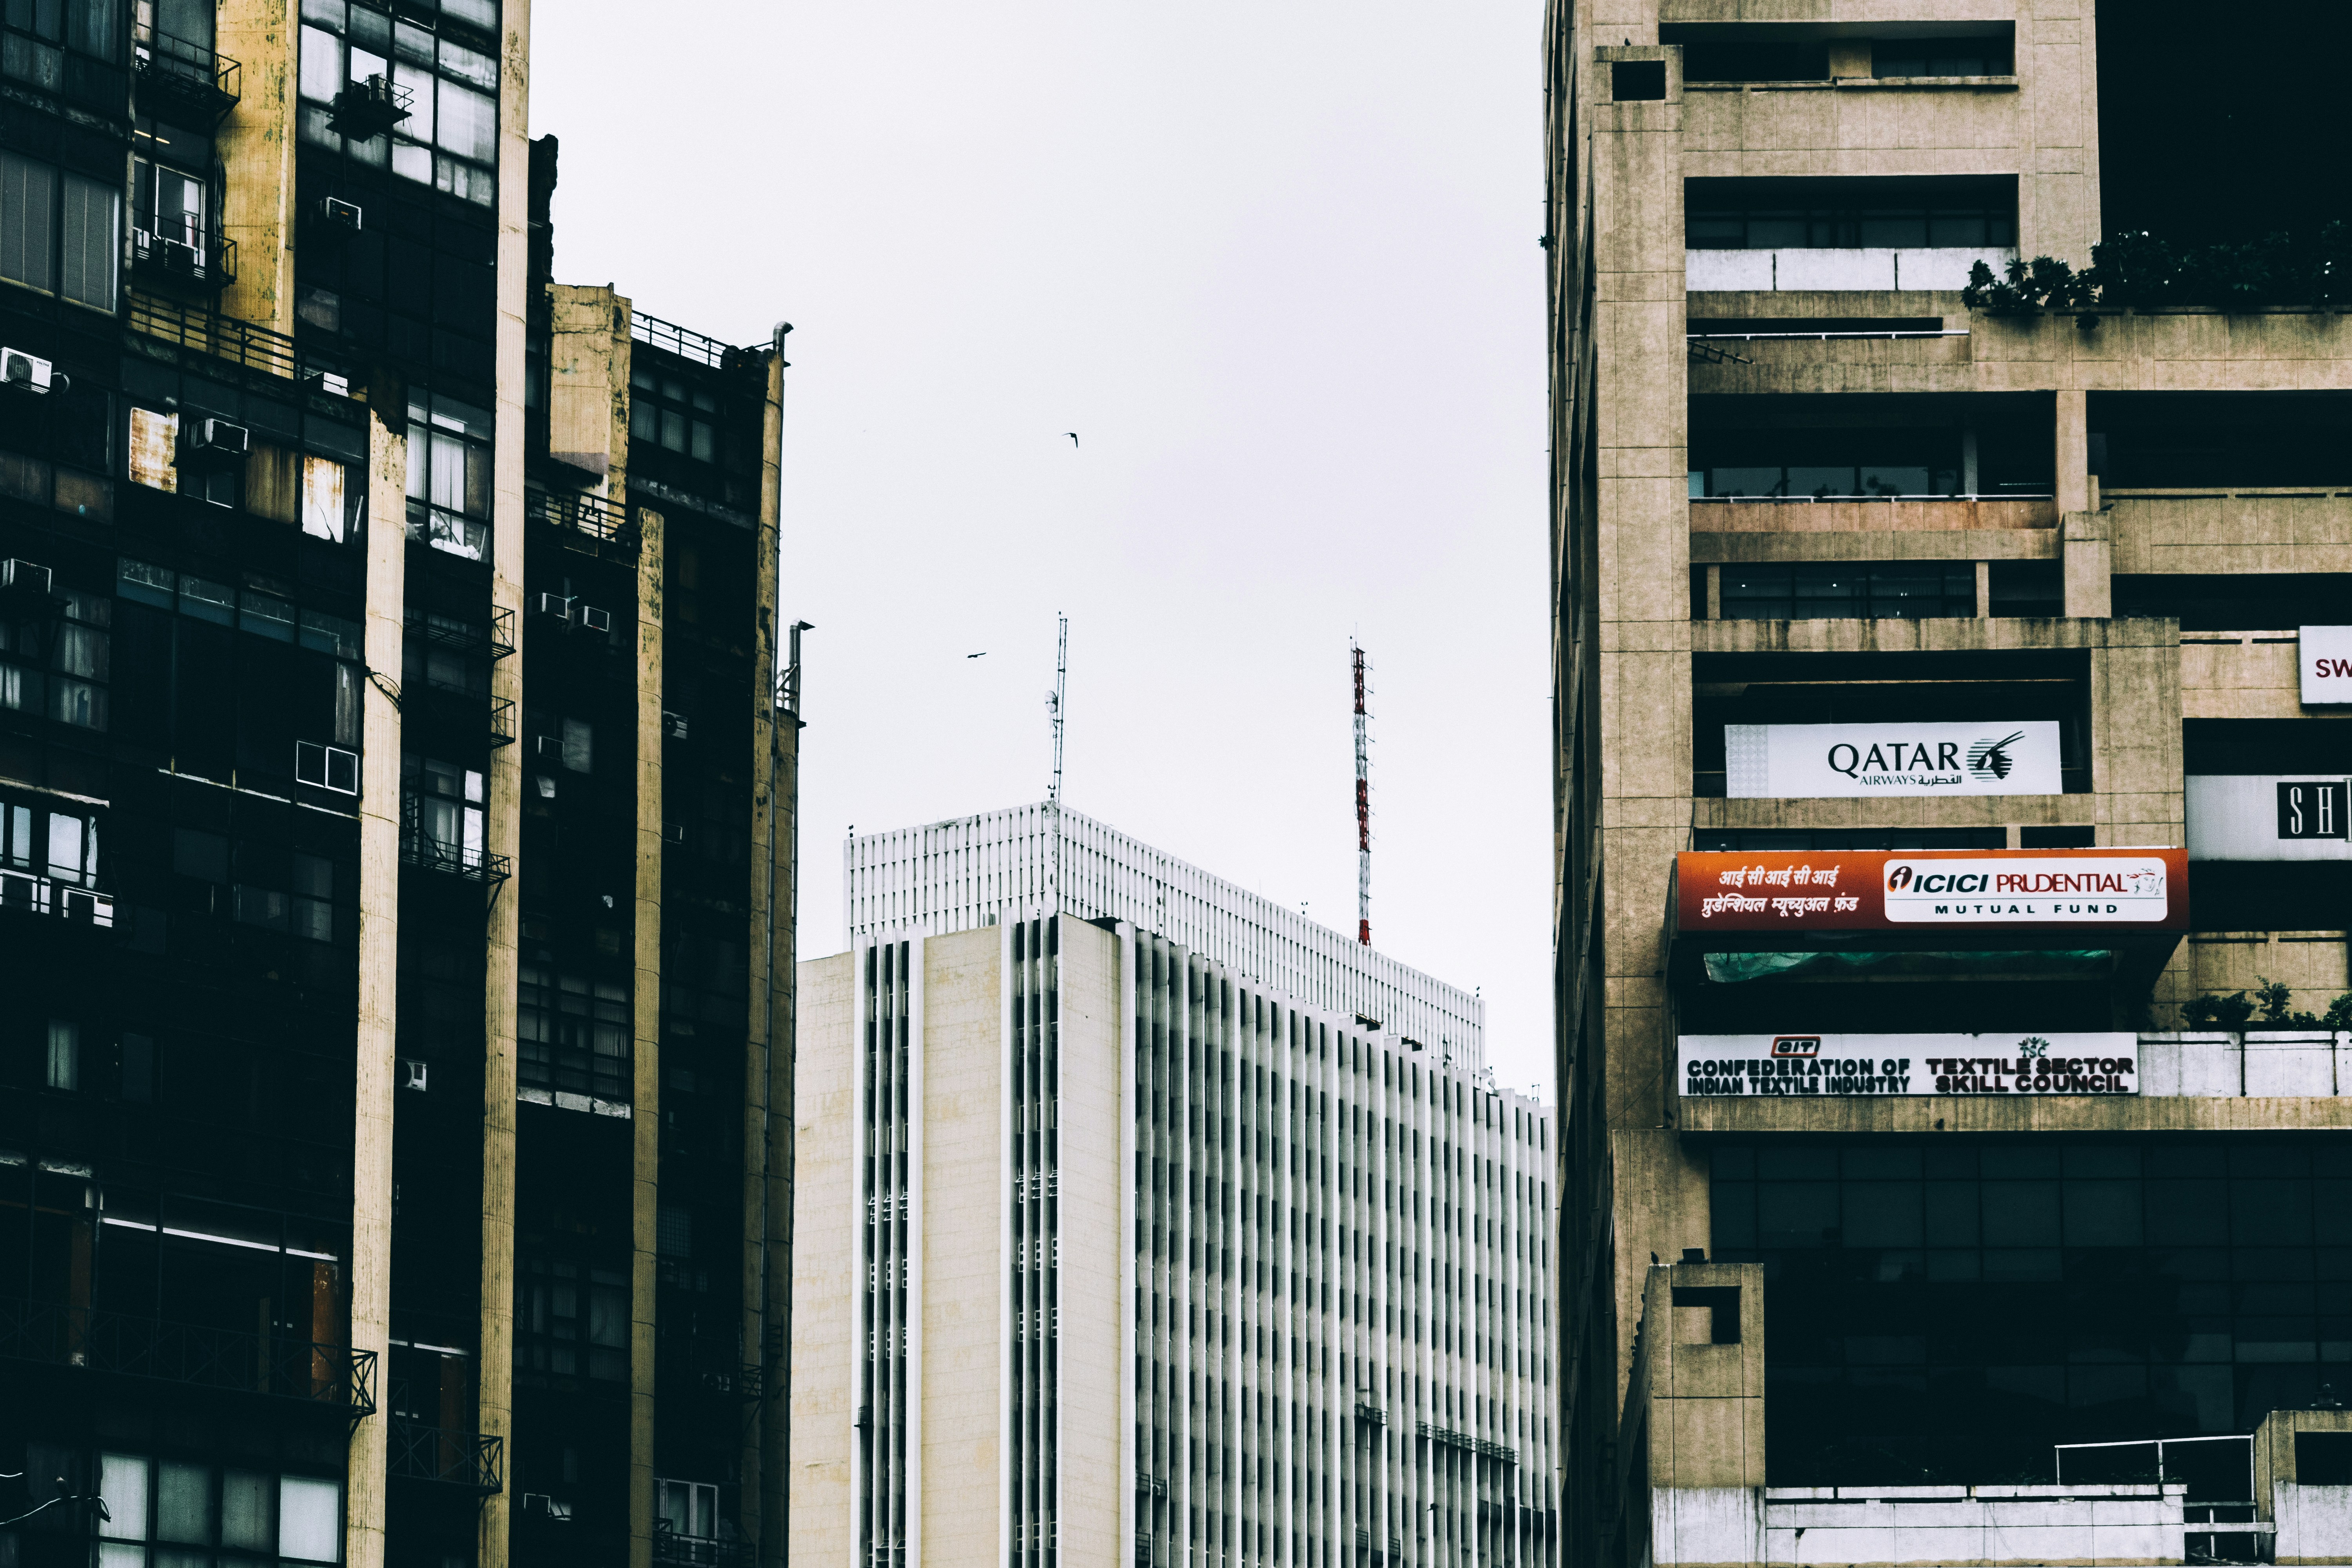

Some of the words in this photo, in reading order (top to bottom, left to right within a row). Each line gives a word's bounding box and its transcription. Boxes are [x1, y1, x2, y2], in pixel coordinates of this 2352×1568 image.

[2316, 659, 2352, 678] SW
[1828, 742, 1960, 779] QATAR
[1859, 774, 1916, 786] AIRWAYS
[1918, 774, 1962, 787] القطرية
[1719, 866, 1747, 888] आई
[1747, 865, 1765, 885] सी
[1764, 865, 1793, 888] आई
[1793, 864, 1812, 885] सी
[1811, 864, 1840, 888] आई
[1913, 873, 1989, 893] ICICI
[1996, 873, 2129, 893] PRUDENTIAL
[1935, 905, 2035, 914] MUTUAL
[2054, 904, 2118, 913] FUND
[2019, 1044, 2046, 1058] TSC
[1687, 1058, 1873, 1076] CONFEDERATION
[1881, 1058, 1910, 1075] OF
[1925, 1058, 2031, 1075] TEXTILE
[2036, 1058, 2134, 1074] SECTOR
[1687, 1076, 1743, 1094] INDIAN
[1749, 1076, 1819, 1094] TEXTILE
[1825, 1076, 1910, 1093] INDUSTRY
[1935, 1074, 2009, 1093] SKILL
[2014, 1074, 2129, 1093] COUNCIL
